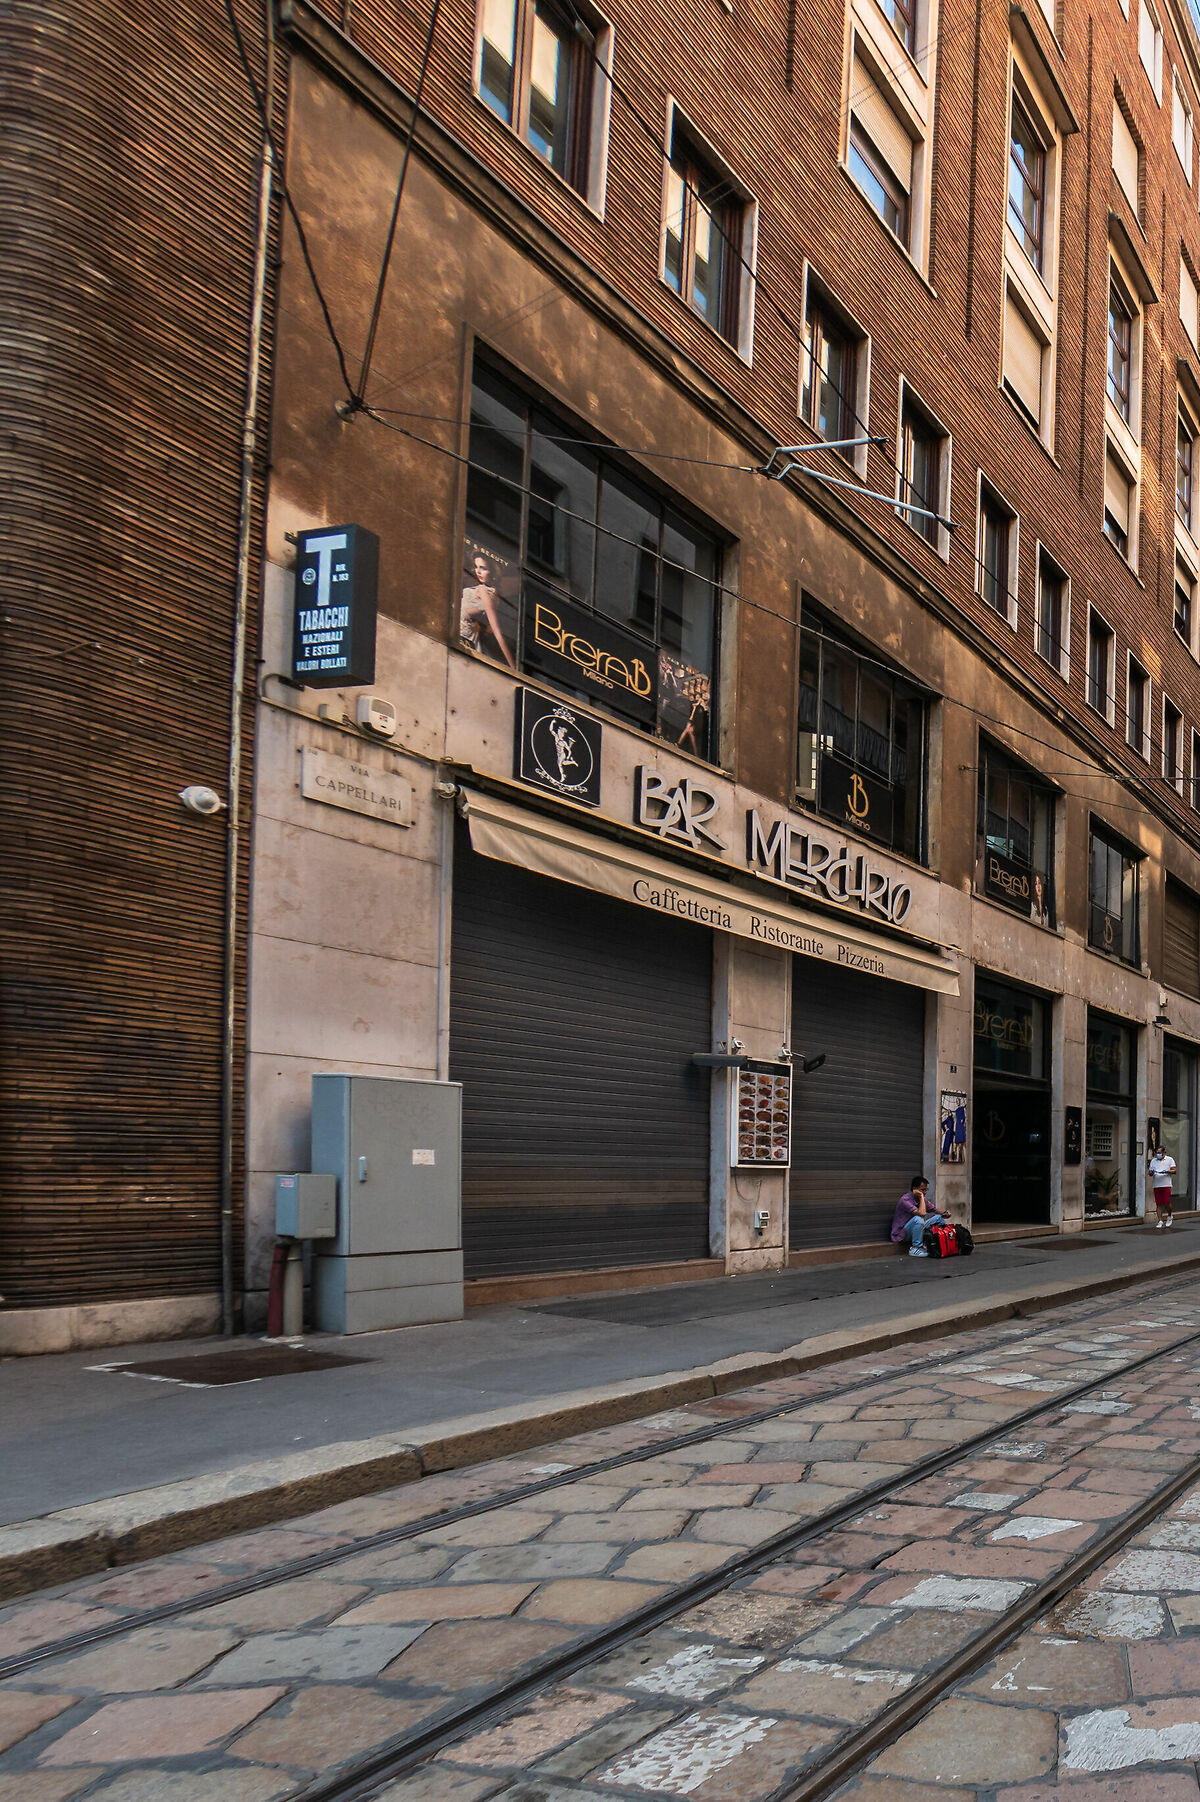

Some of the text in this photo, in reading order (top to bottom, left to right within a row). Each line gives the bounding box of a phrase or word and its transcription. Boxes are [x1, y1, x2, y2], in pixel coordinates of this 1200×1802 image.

[305, 534, 347, 606] T
[299, 606, 349, 631] TABACCHI
[302, 631, 343, 644] NAZIONALI
[304, 644, 340, 657] E ESTERI
[296, 657, 347, 672] VALORI BOLLATI
[583, 668, 614, 689] Milano
[350, 765, 369, 778] VIA
[315, 775, 402, 811] CAPPELLARI
[845, 811, 871, 831] Milano
[635, 765, 912, 925] BAR MERCURIO
[632, 879, 886, 975] Caffetteria Ristorante Pizzeria
